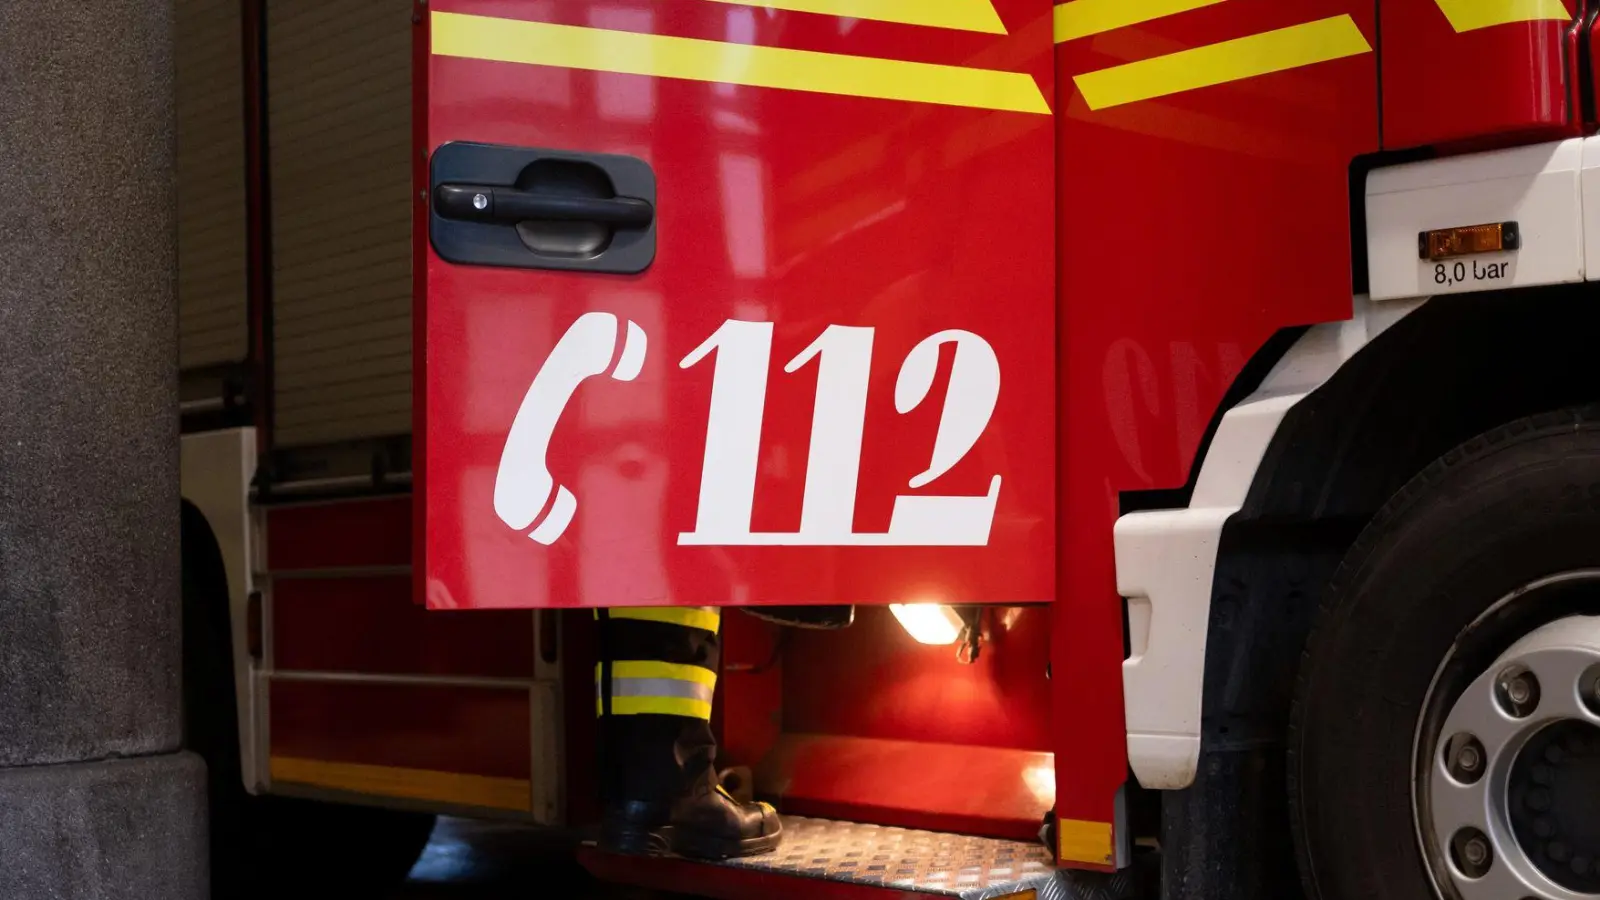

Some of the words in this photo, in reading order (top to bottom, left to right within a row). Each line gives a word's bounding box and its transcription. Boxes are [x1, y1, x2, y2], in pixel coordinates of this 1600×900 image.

[1434, 261, 1466, 287] 8,0
[1473, 260, 1509, 280] bar
[677, 319, 1002, 546] 112
